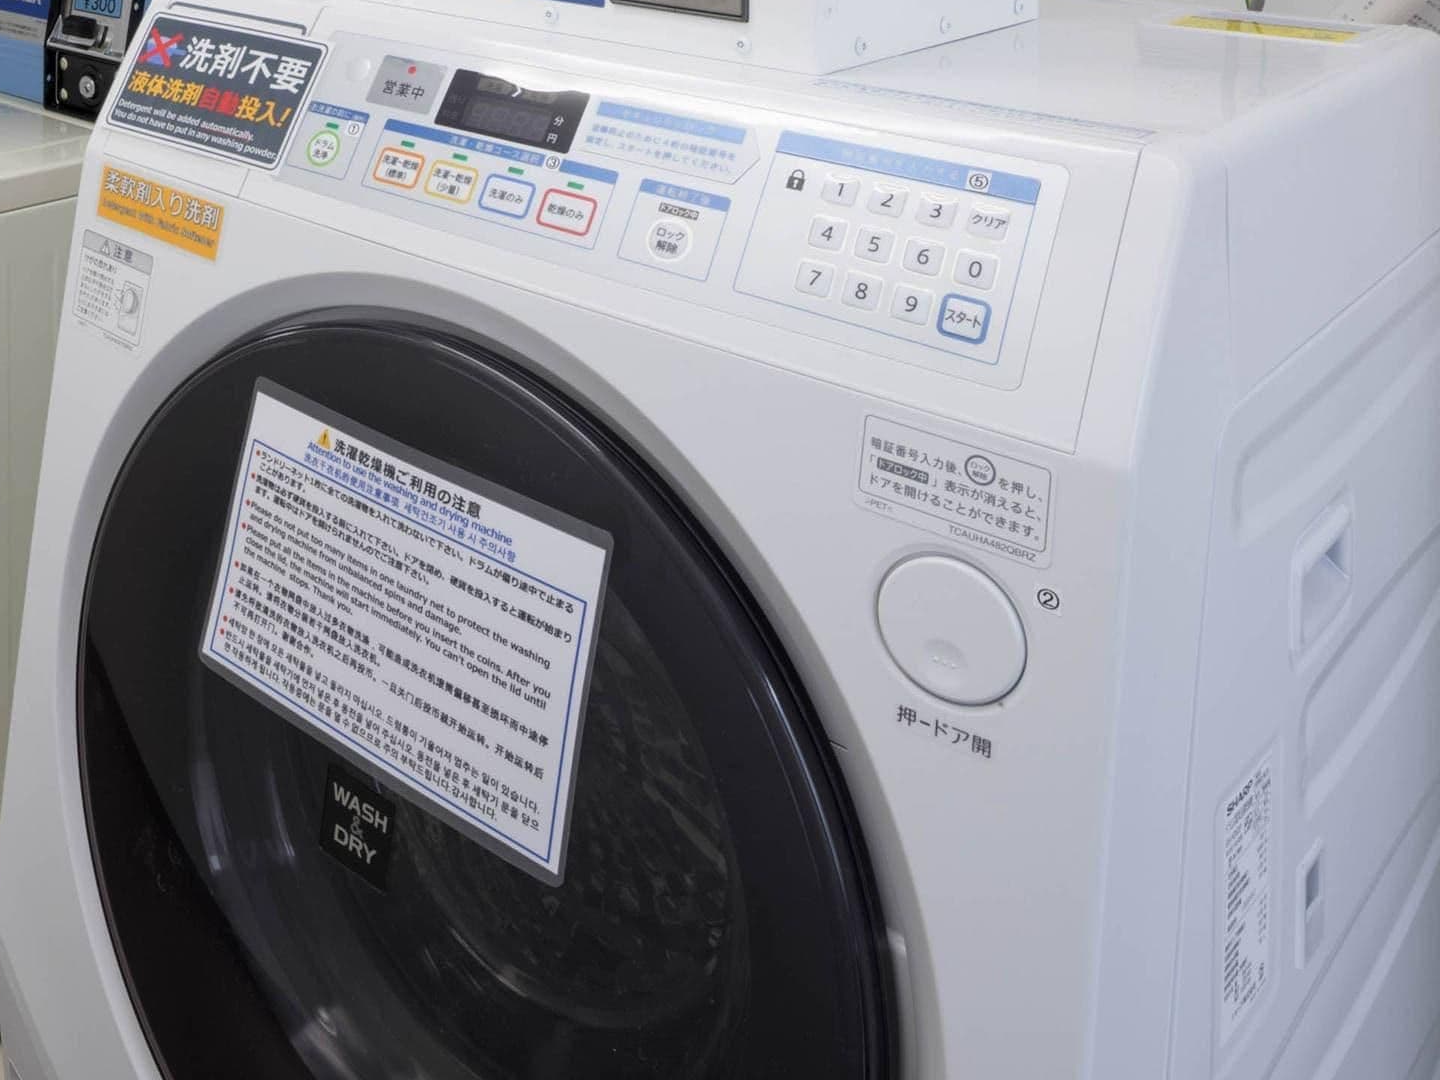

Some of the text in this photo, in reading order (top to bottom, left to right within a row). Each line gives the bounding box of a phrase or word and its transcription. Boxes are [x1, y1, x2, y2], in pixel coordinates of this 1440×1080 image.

[179, 34, 312, 95] 洗剤不要
[382, 79, 425, 99] 営業中
[546, 133, 558, 145] 円
[552, 115, 565, 128] 分
[105, 169, 219, 230] 柔軟剤入り洗剤
[488, 187, 524, 204] 洗濯のみ
[547, 201, 585, 221] 乾燥のみ
[837, 183, 942, 219] 1 2 3
[656, 226, 685, 242] ロック
[971, 213, 1007, 230] クリア
[655, 239, 678, 255] 解除
[821, 226, 982, 278] 4 5 6 0
[810, 270, 918, 313] 7 8 9
[944, 308, 982, 328] スタート
[259, 462, 306, 493] ことがあります。
[306, 441, 512, 549] Attention to use the washing and drying machine
[333, 437, 481, 520] 洗濯乾燥機ご利用の注意
[870, 473, 1039, 542] ドアを開けることができます。
[243, 546, 353, 615] the machine stops. Thank you.
[249, 512, 463, 636] and drying machine from unbalanced spins and damage.
[250, 502, 550, 670] Please do not put too many items in one laundry net to protect the washing
[245, 525, 551, 700] Please put all the items in the machine before you insert the coins. After you
[333, 781, 388, 833] WASH
[333, 823, 377, 864] DRY
